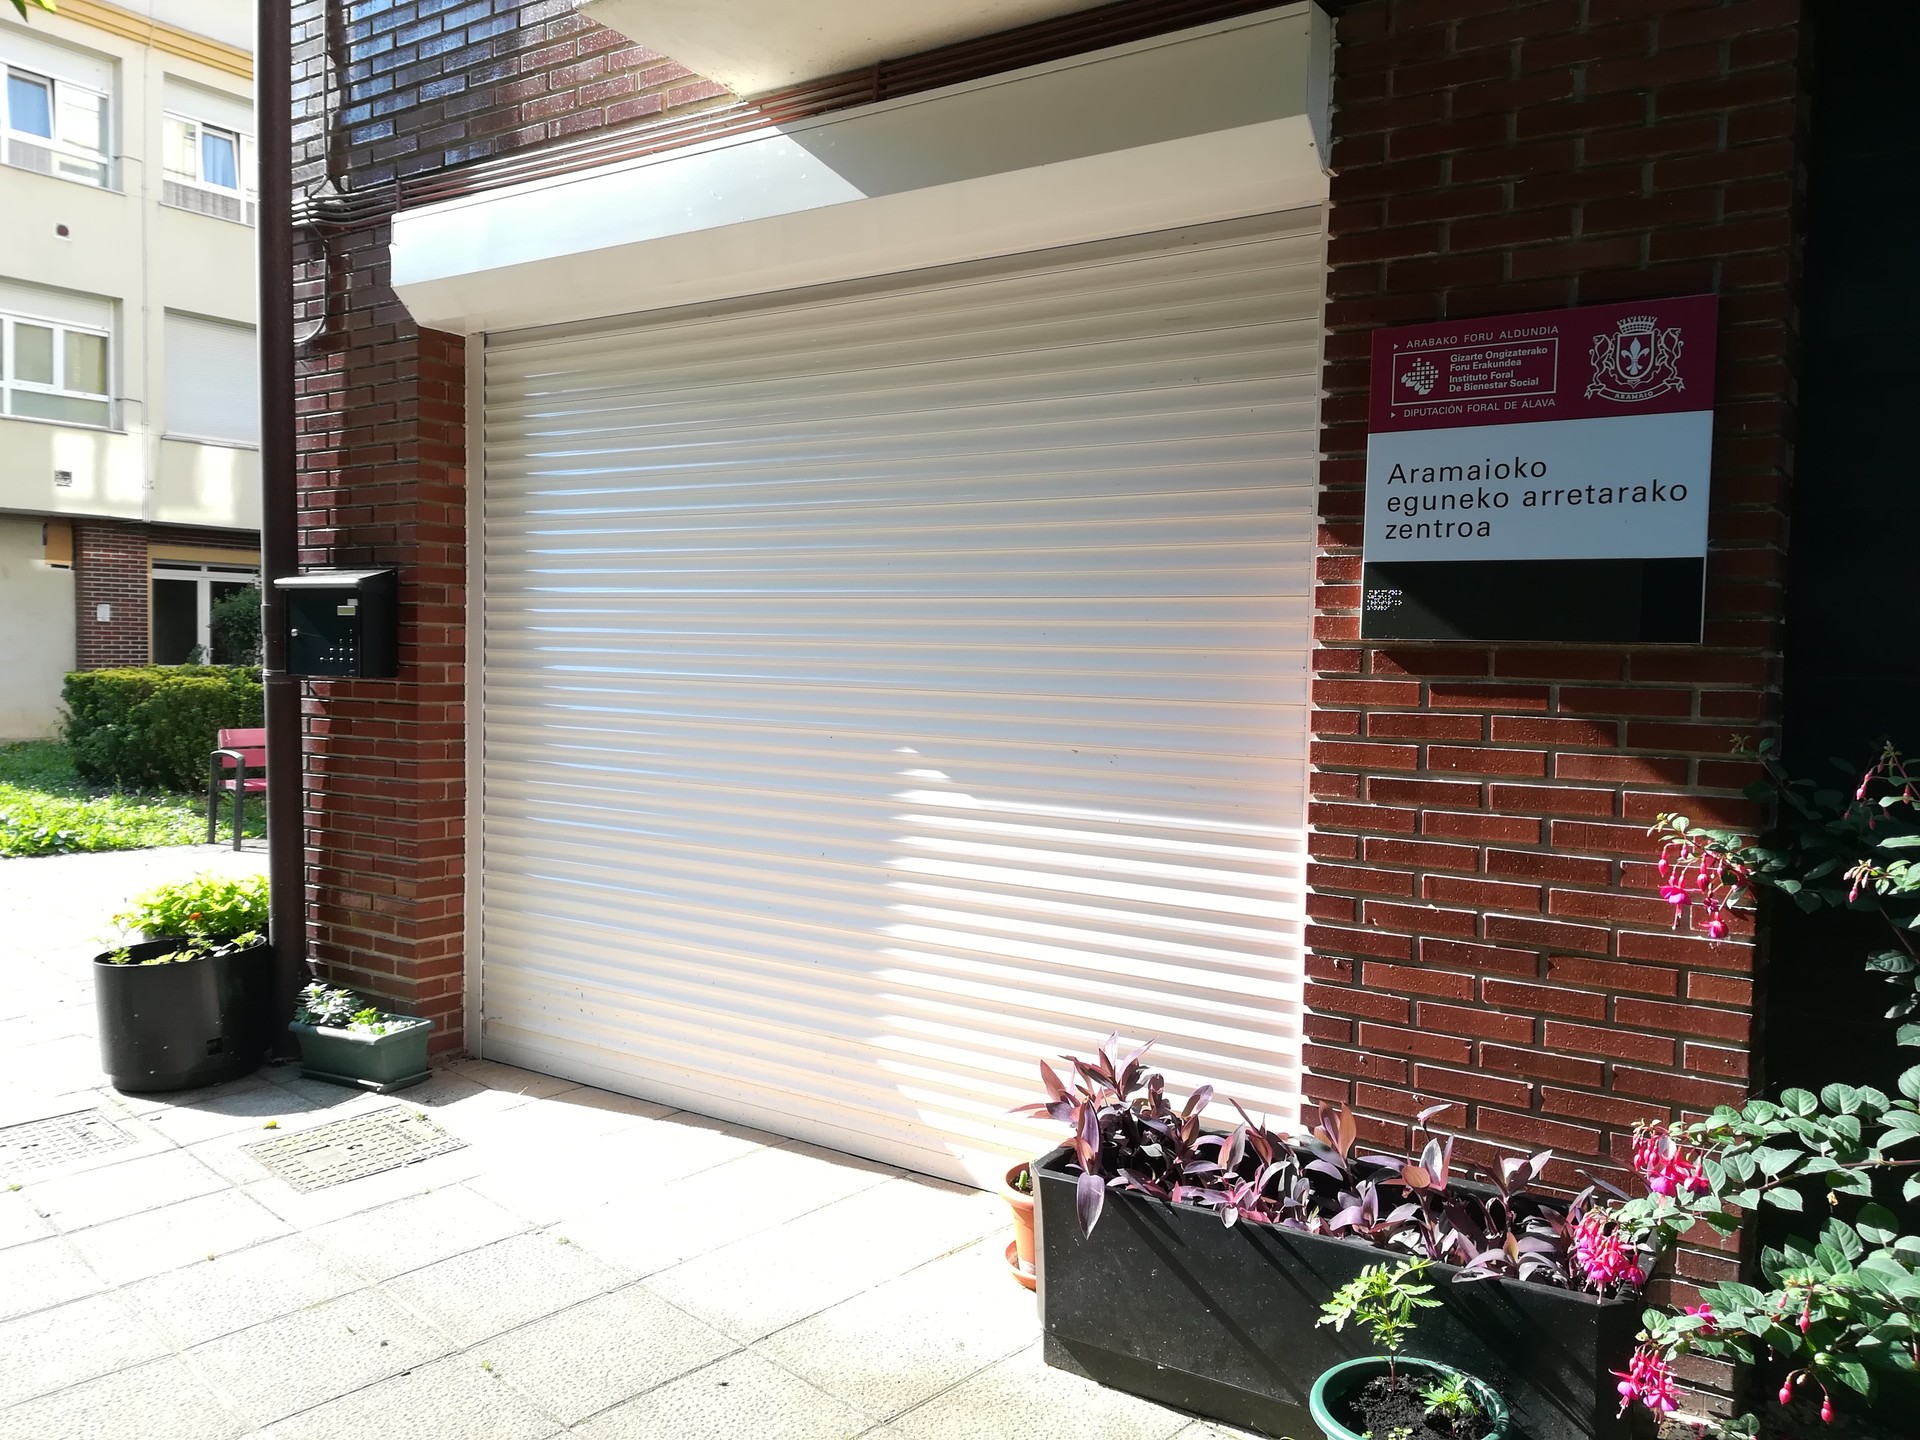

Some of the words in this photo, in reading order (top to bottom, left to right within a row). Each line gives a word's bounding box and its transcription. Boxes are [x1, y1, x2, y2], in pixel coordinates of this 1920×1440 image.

[1406, 335, 1458, 349] ARABAKO
[1464, 331, 1494, 343] FORU
[1499, 325, 1559, 340] ALDUNDIA
[1450, 352, 1483, 362] Gizarte
[1485, 346, 1548, 361] Ongizaterako
[1450, 362, 1470, 372] Foru
[1472, 358, 1522, 370] Erakundea
[1449, 372, 1488, 383] Instituto
[1490, 370, 1514, 380] Foral
[1449, 383, 1461, 392] De
[1463, 379, 1507, 391] Bienestar
[1509, 377, 1539, 388] Social
[1614, 391, 1653, 400] ARAMAIO
[1404, 404, 1463, 418] DIPUTACIÓN
[1467, 401, 1500, 413] FORAL
[1504, 401, 1517, 410] DE
[1521, 397, 1556, 409] ÁLAVA
[1387, 456, 1547, 485] Aramaioko
[1387, 486, 1509, 517] eguneko
[1523, 479, 1688, 507] arretarako
[1385, 519, 1491, 540] zentroa
